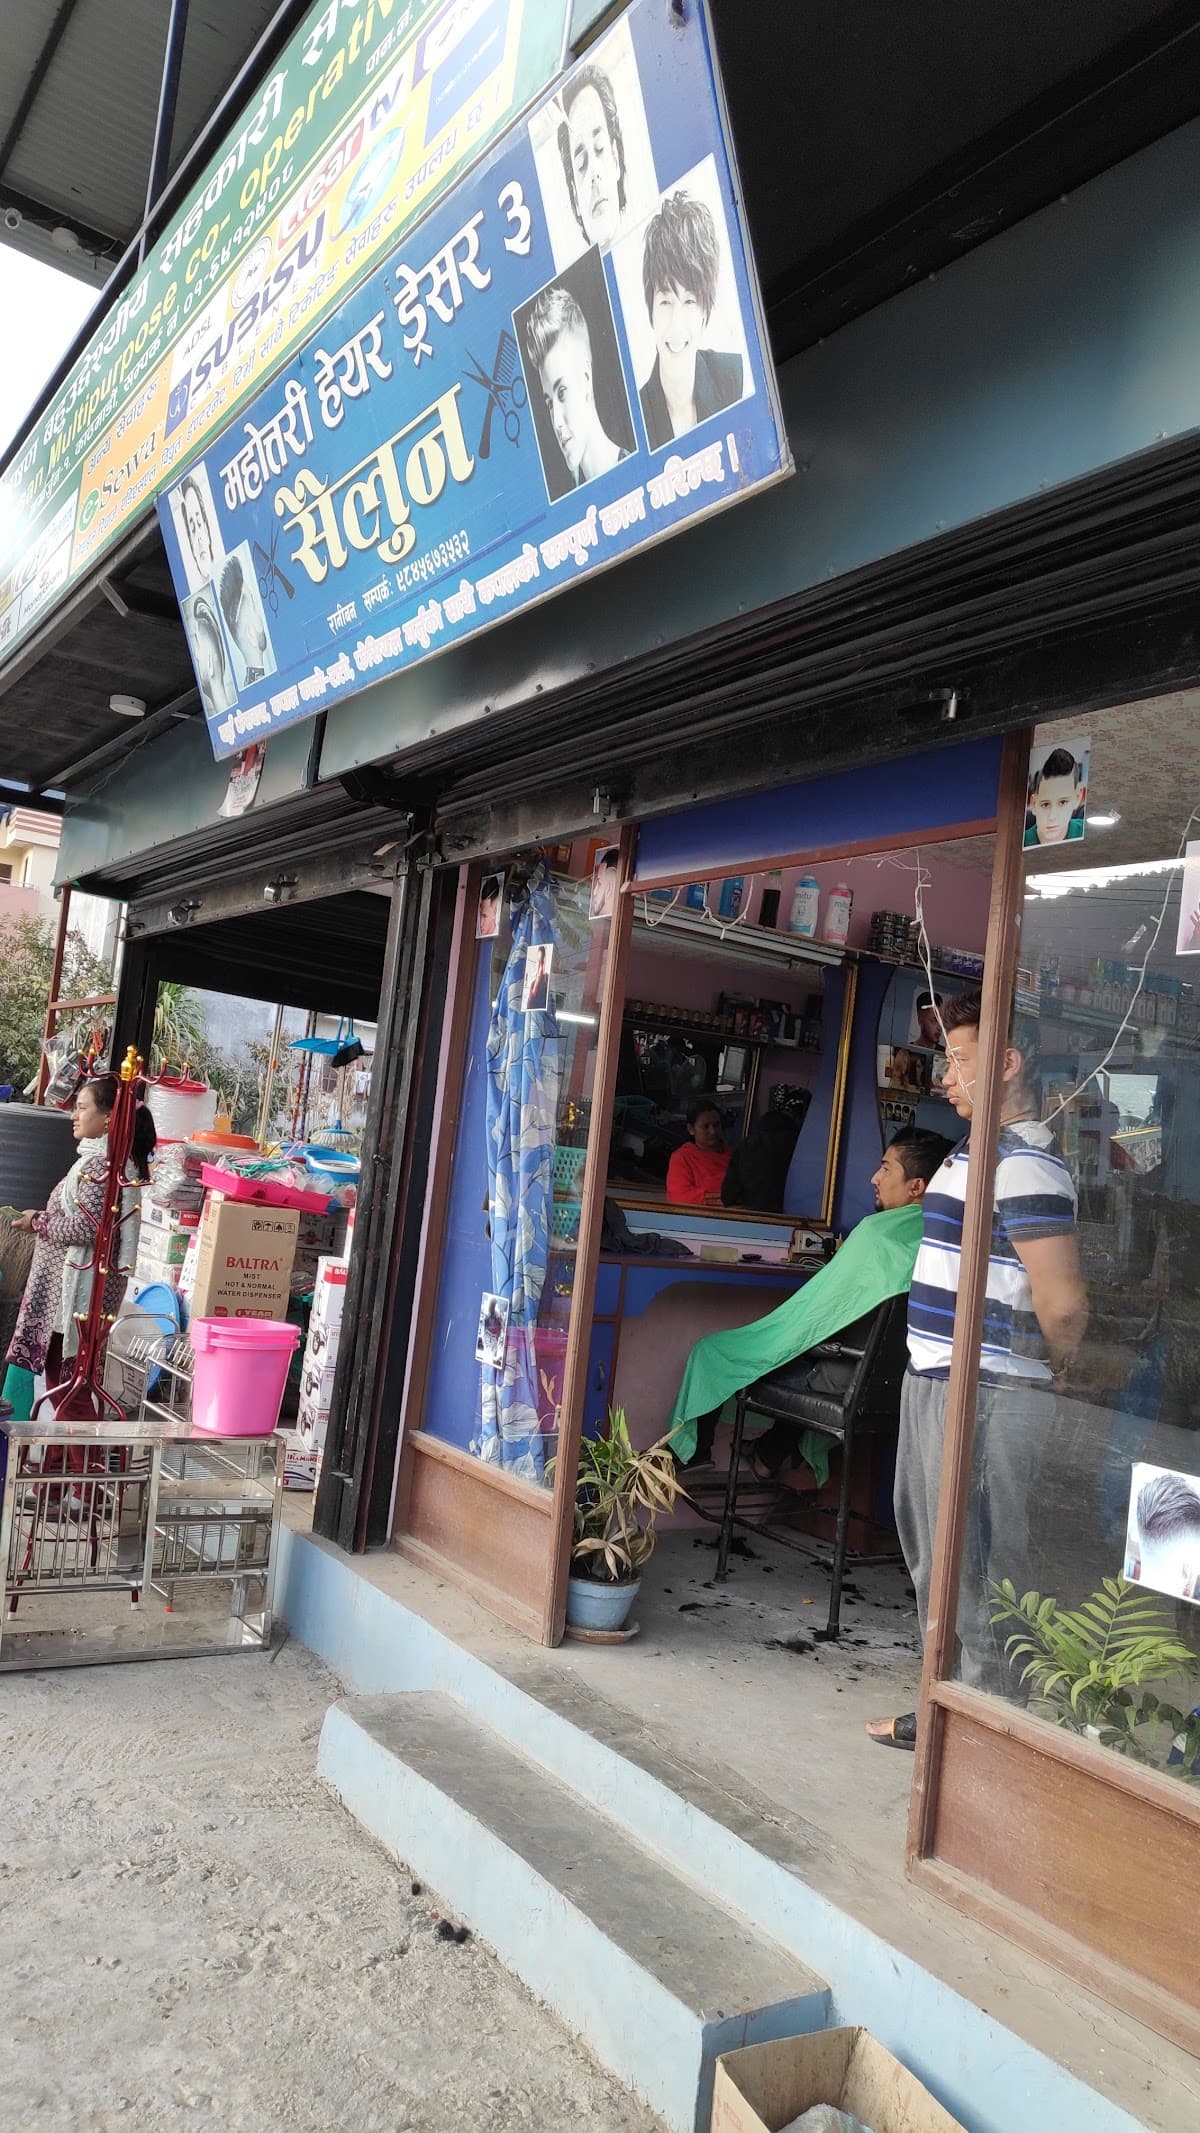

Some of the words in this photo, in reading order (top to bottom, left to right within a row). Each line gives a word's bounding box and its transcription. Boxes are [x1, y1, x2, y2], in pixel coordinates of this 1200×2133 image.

[160, 70, 288, 274] सहकारी
[48, 282, 176, 475] Multipurpose
[186, 214, 230, 284] co-
[220, 380, 313, 510] महोत्तरी
[314, 310, 392, 427] हेयर
[394, 210, 490, 365] ड्रेसर
[498, 181, 530, 254] ३
[226, 1256, 279, 1271] BALTRA
